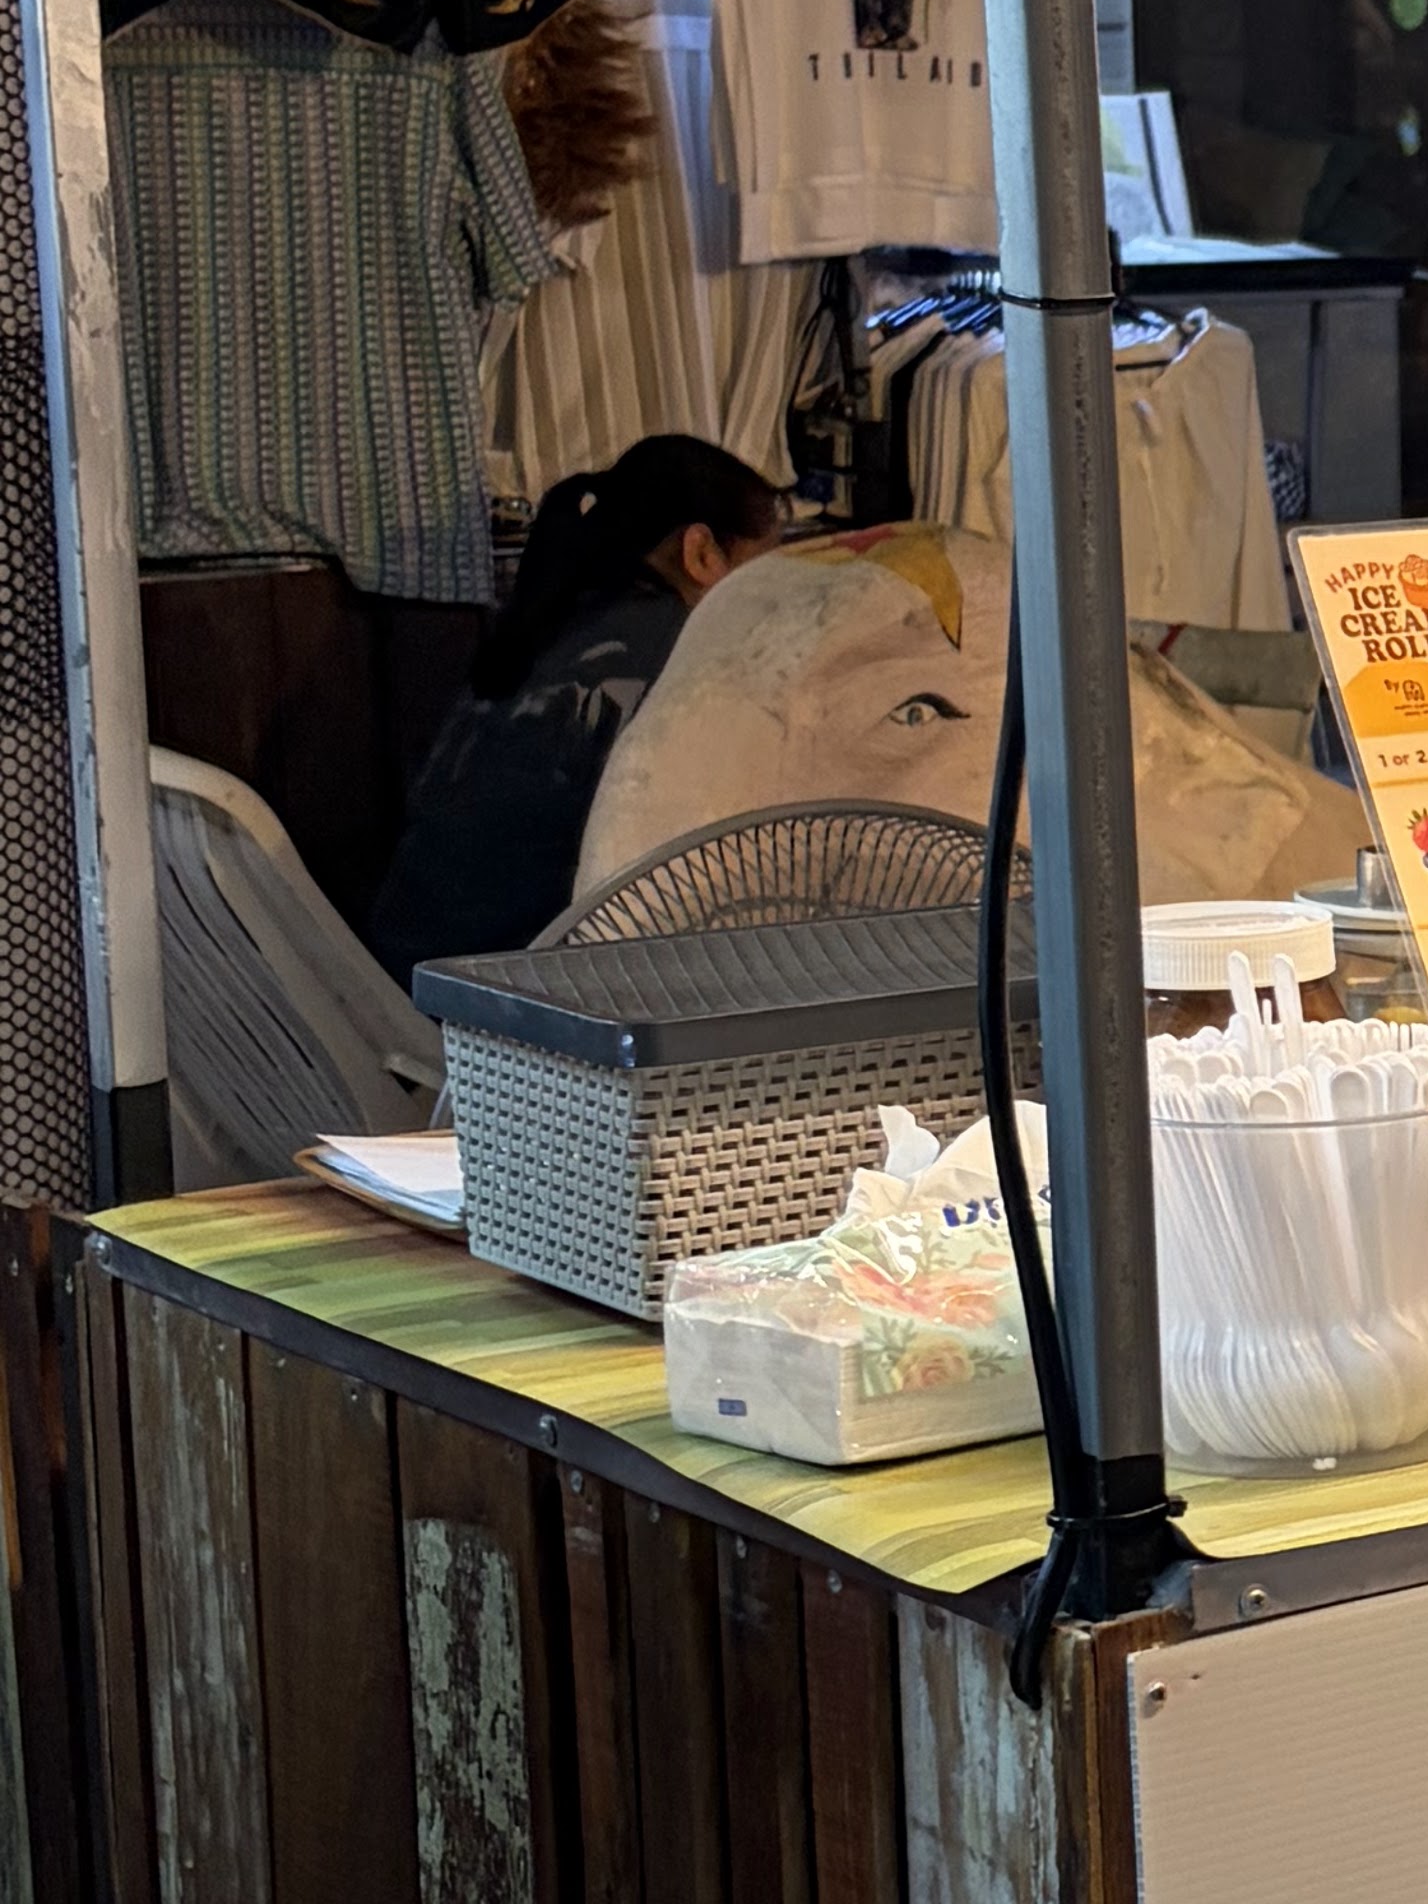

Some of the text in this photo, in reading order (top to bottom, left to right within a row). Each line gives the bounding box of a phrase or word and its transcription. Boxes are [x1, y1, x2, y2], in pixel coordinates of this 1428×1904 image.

[1325, 562, 1394, 593] HAPPY
[1348, 585, 1401, 611] ICE
[1377, 754, 1388, 768] 1
[1393, 754, 1410, 766] or
[1416, 750, 1428, 764] 2
